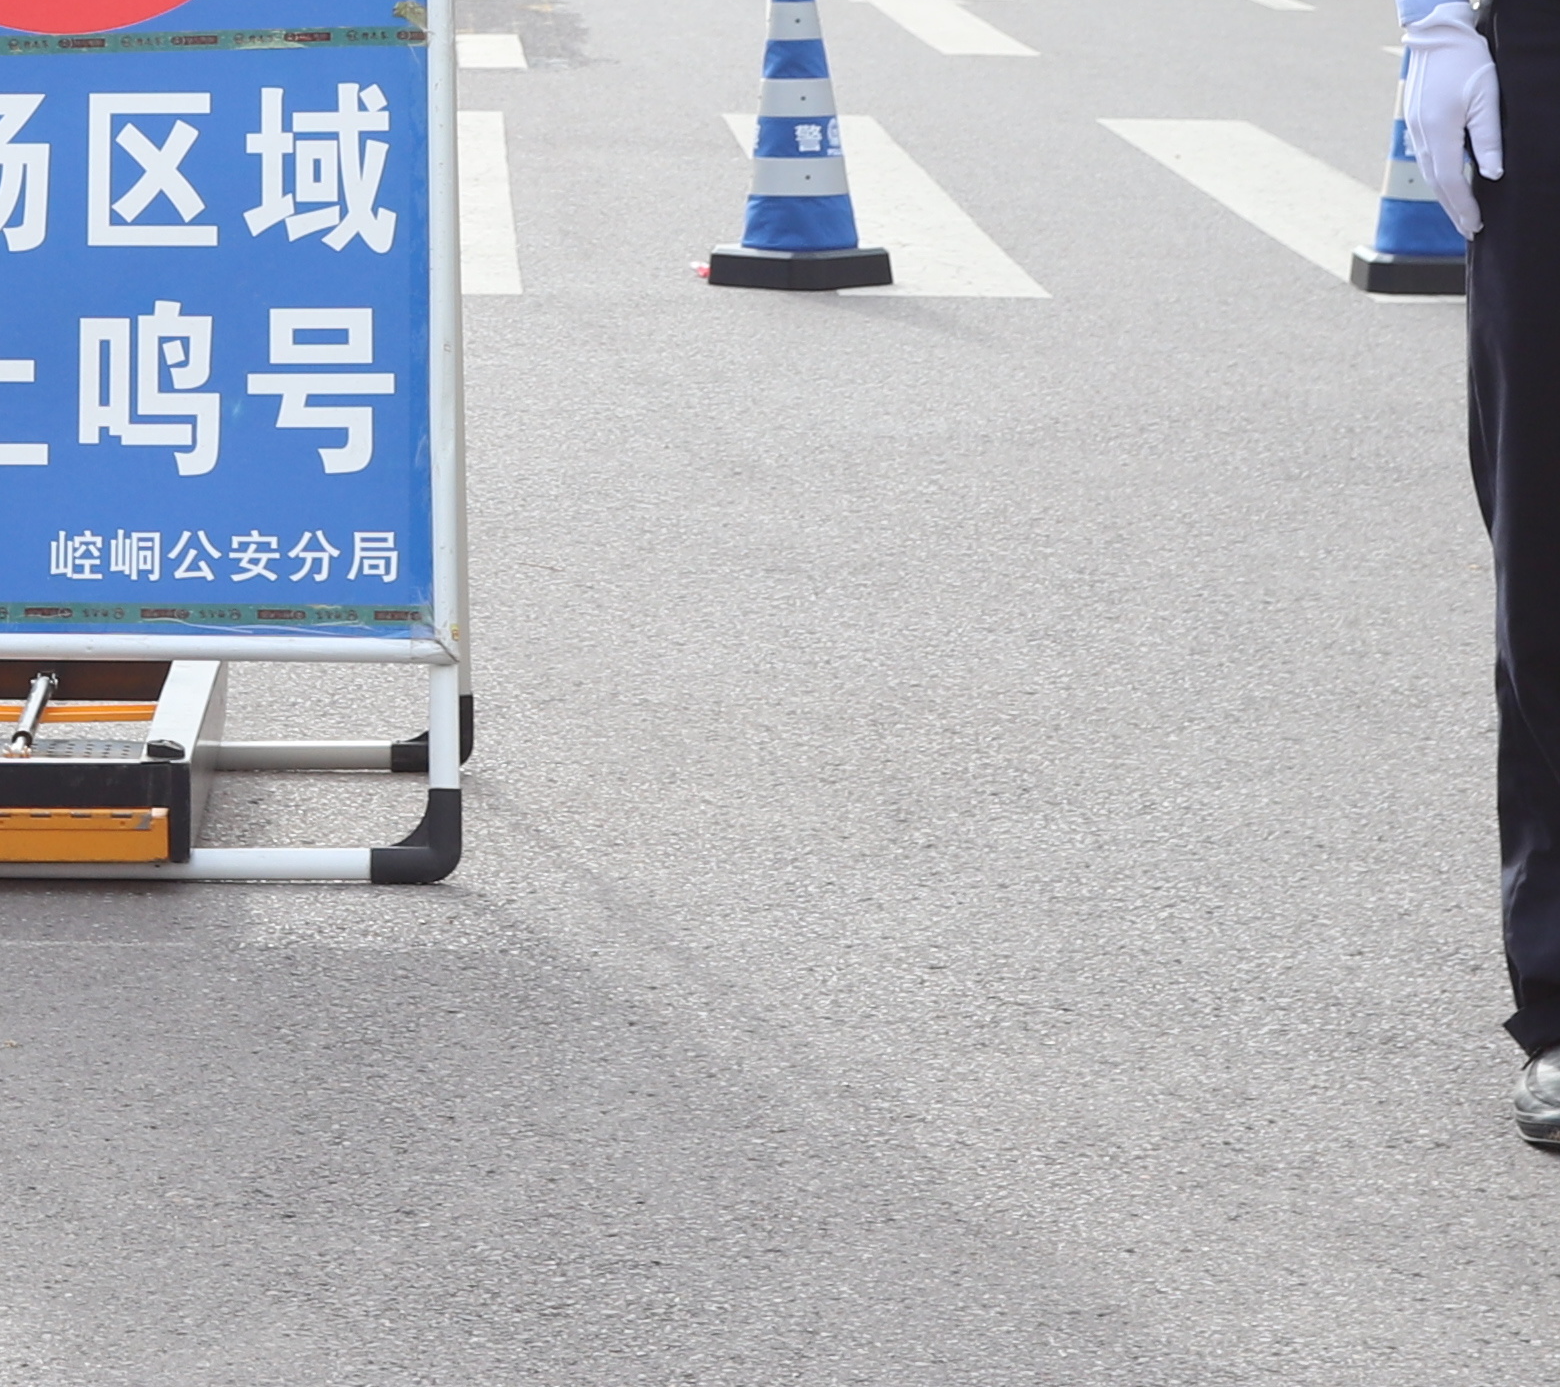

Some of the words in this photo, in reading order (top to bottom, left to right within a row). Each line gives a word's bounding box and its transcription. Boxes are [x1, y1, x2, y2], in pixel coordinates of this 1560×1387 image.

[49, 527, 400, 583] 崆峒公安分局
